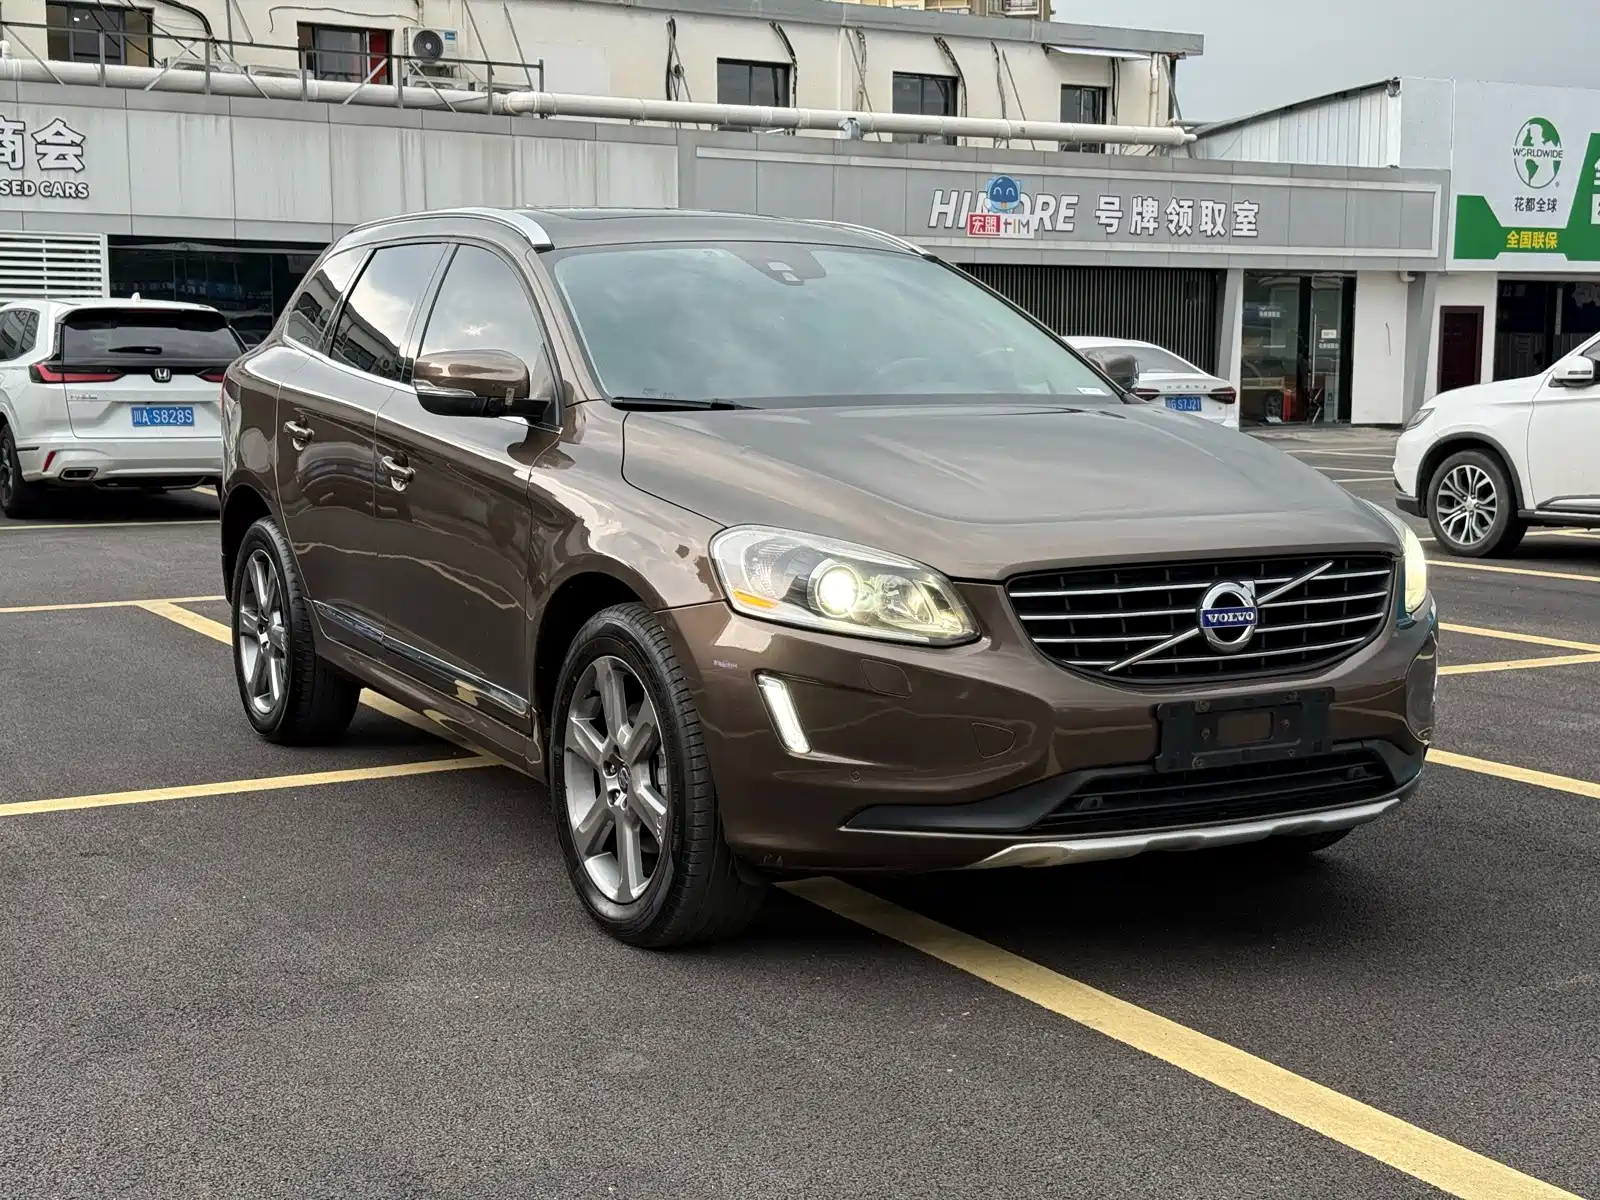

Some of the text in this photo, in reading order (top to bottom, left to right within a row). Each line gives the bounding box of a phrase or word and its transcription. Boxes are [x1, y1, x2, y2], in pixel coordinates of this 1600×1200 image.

[1512, 147, 1564, 159] WORLDWIDE
[38, 180, 89, 199] CARS
[1514, 196, 1558, 213] 花都全球
[972, 216, 997, 234] 宏盟
[1094, 195, 1259, 238] 号牌领取室
[1506, 230, 1558, 249] 全国联保
[1206, 611, 1254, 623] VOLVO
